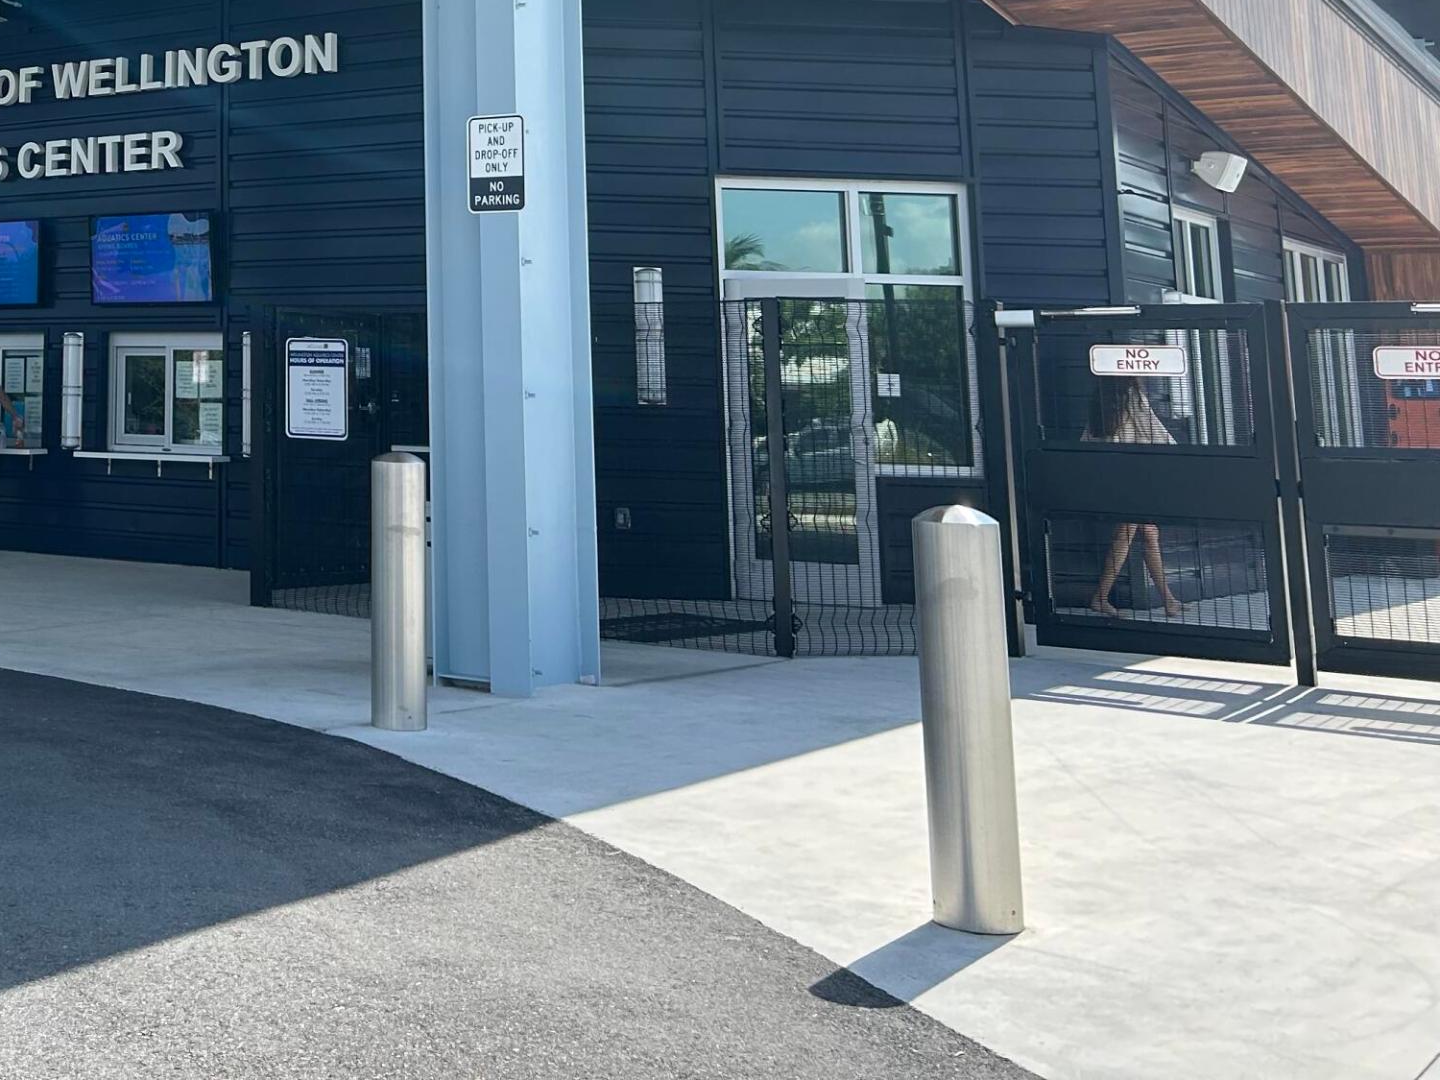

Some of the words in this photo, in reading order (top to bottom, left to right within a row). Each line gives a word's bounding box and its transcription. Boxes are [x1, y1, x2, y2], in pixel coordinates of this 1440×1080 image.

[51, 32, 338, 100] WELLINGTON
[478, 122, 514, 133] PICK-UP
[487, 135, 505, 146] AND
[17, 130, 183, 180] CENTER
[474, 148, 518, 160] DROP-OFF
[485, 162, 508, 173] ONLY
[489, 181, 504, 192] NO
[474, 194, 520, 206] PARKING
[1125, 349, 1150, 359] NO
[1415, 350, 1440, 361] NO
[1116, 360, 1160, 370] ENTRY
[1404, 362, 1440, 373] ENTR
